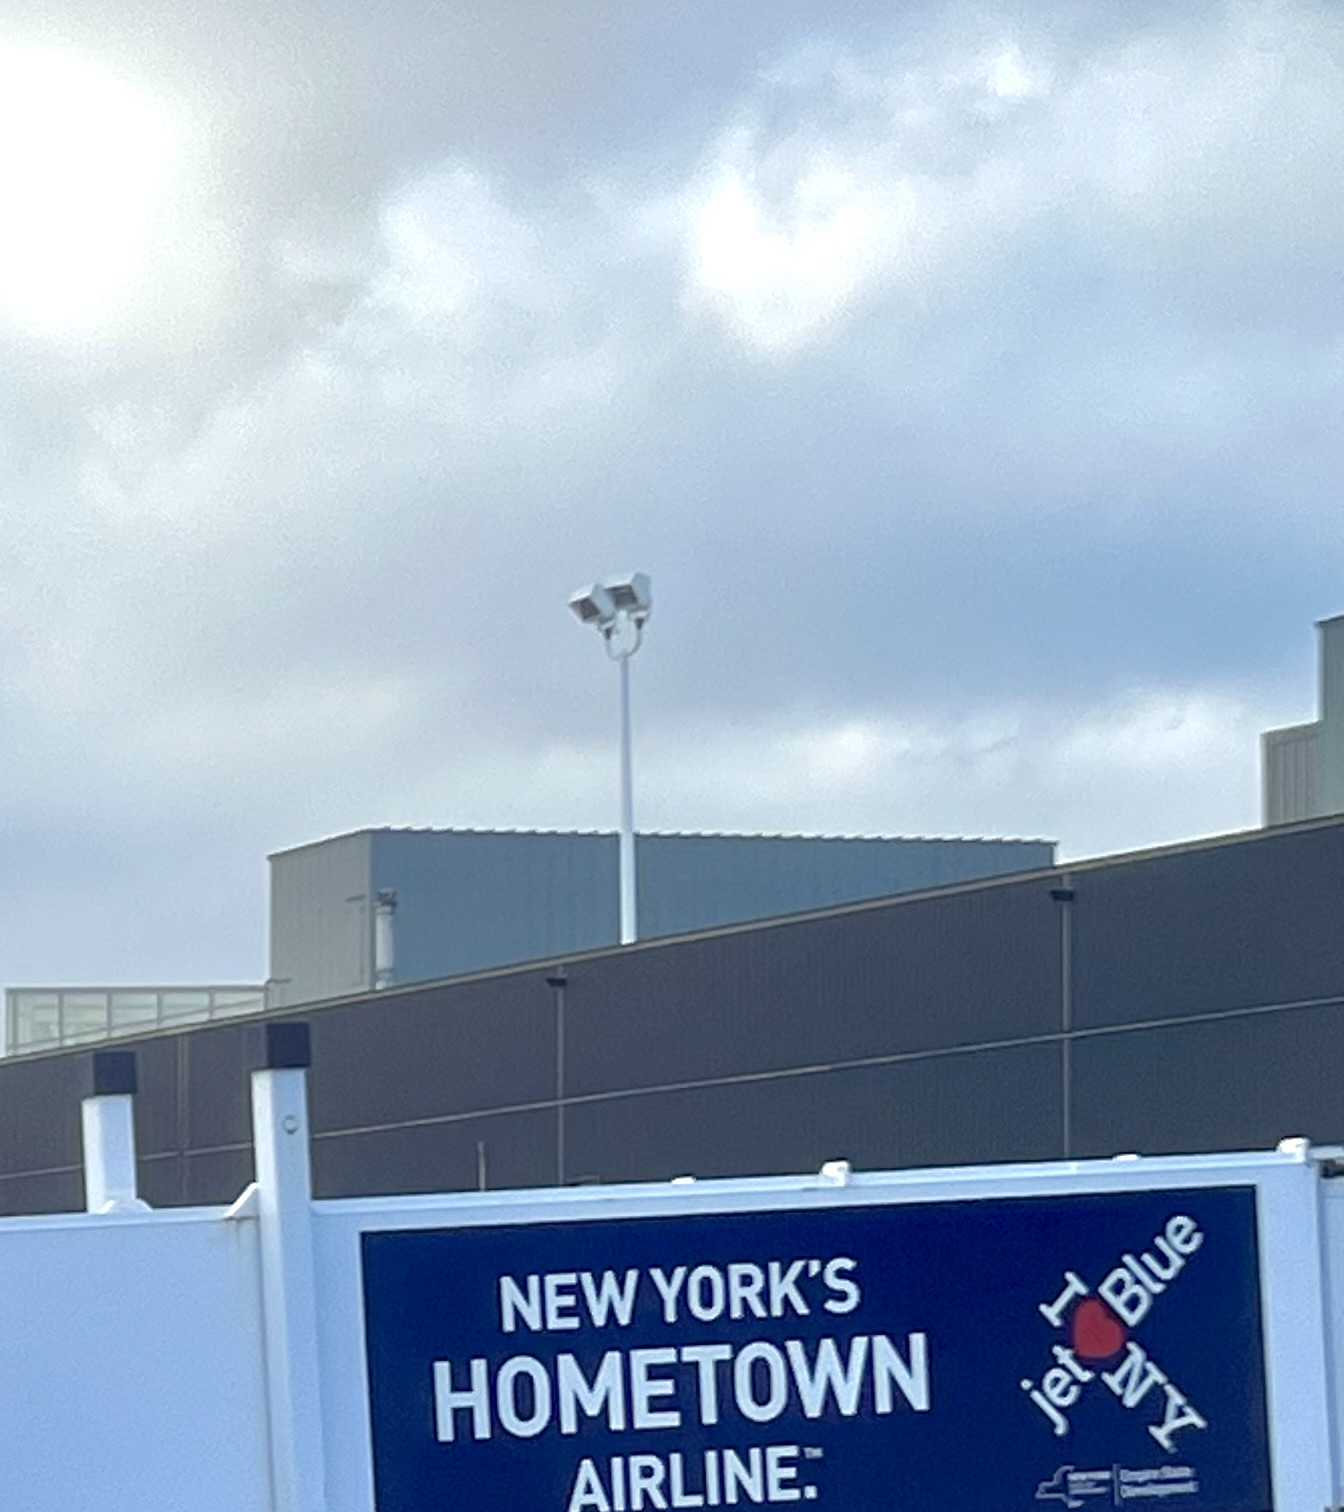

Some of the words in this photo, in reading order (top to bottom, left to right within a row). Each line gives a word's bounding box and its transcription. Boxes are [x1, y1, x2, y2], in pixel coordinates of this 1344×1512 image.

[499, 1268, 639, 1332] NEW
[648, 1257, 861, 1323] YORK'S
[1020, 1344, 1095, 1436] jet
[1097, 1215, 1205, 1327] Blue
[1038, 1271, 1089, 1327] I
[1100, 1341, 1208, 1453] NY
[432, 1332, 930, 1442] HOMETOWN
